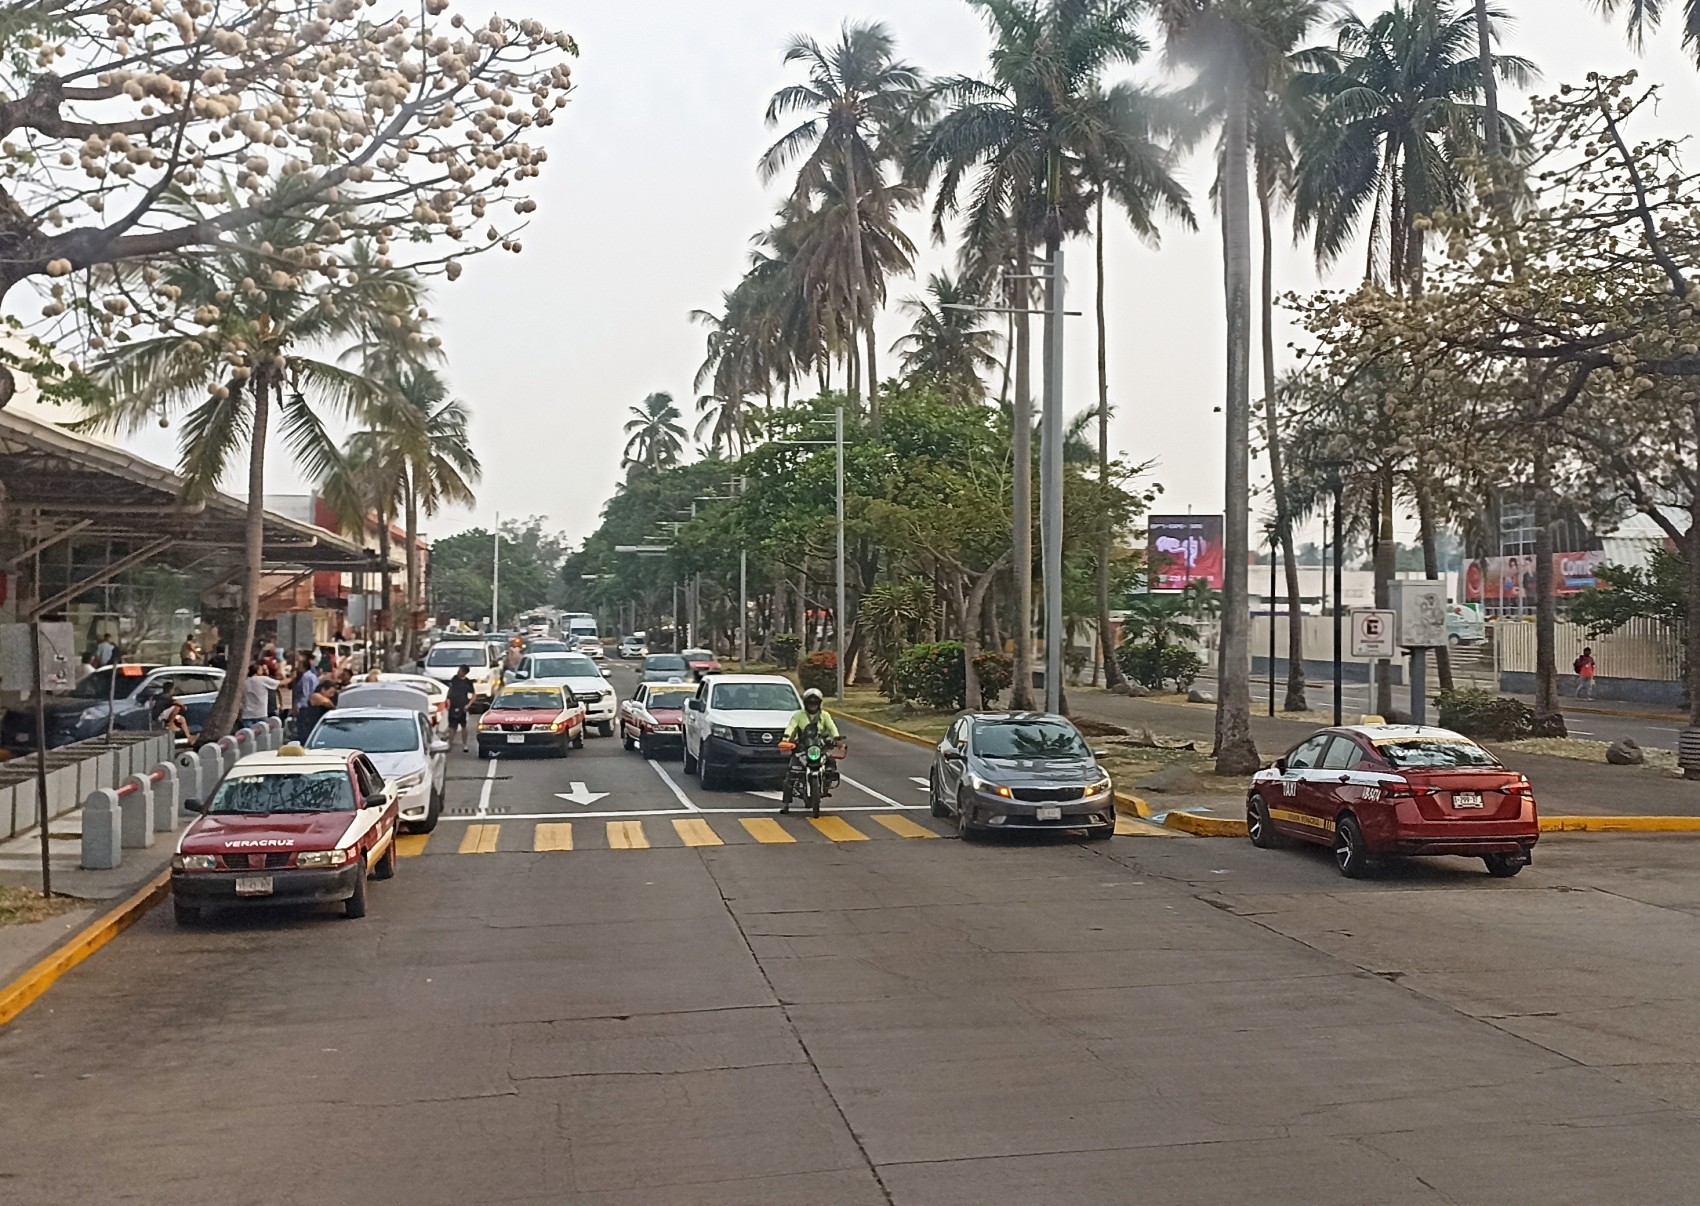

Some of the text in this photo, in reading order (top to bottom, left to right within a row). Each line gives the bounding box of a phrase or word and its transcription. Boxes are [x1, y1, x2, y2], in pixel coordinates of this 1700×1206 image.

[1366, 619, 1379, 635] E
[1282, 781, 1297, 797] TAXI
[224, 839, 295, 848] VERACRUZ
